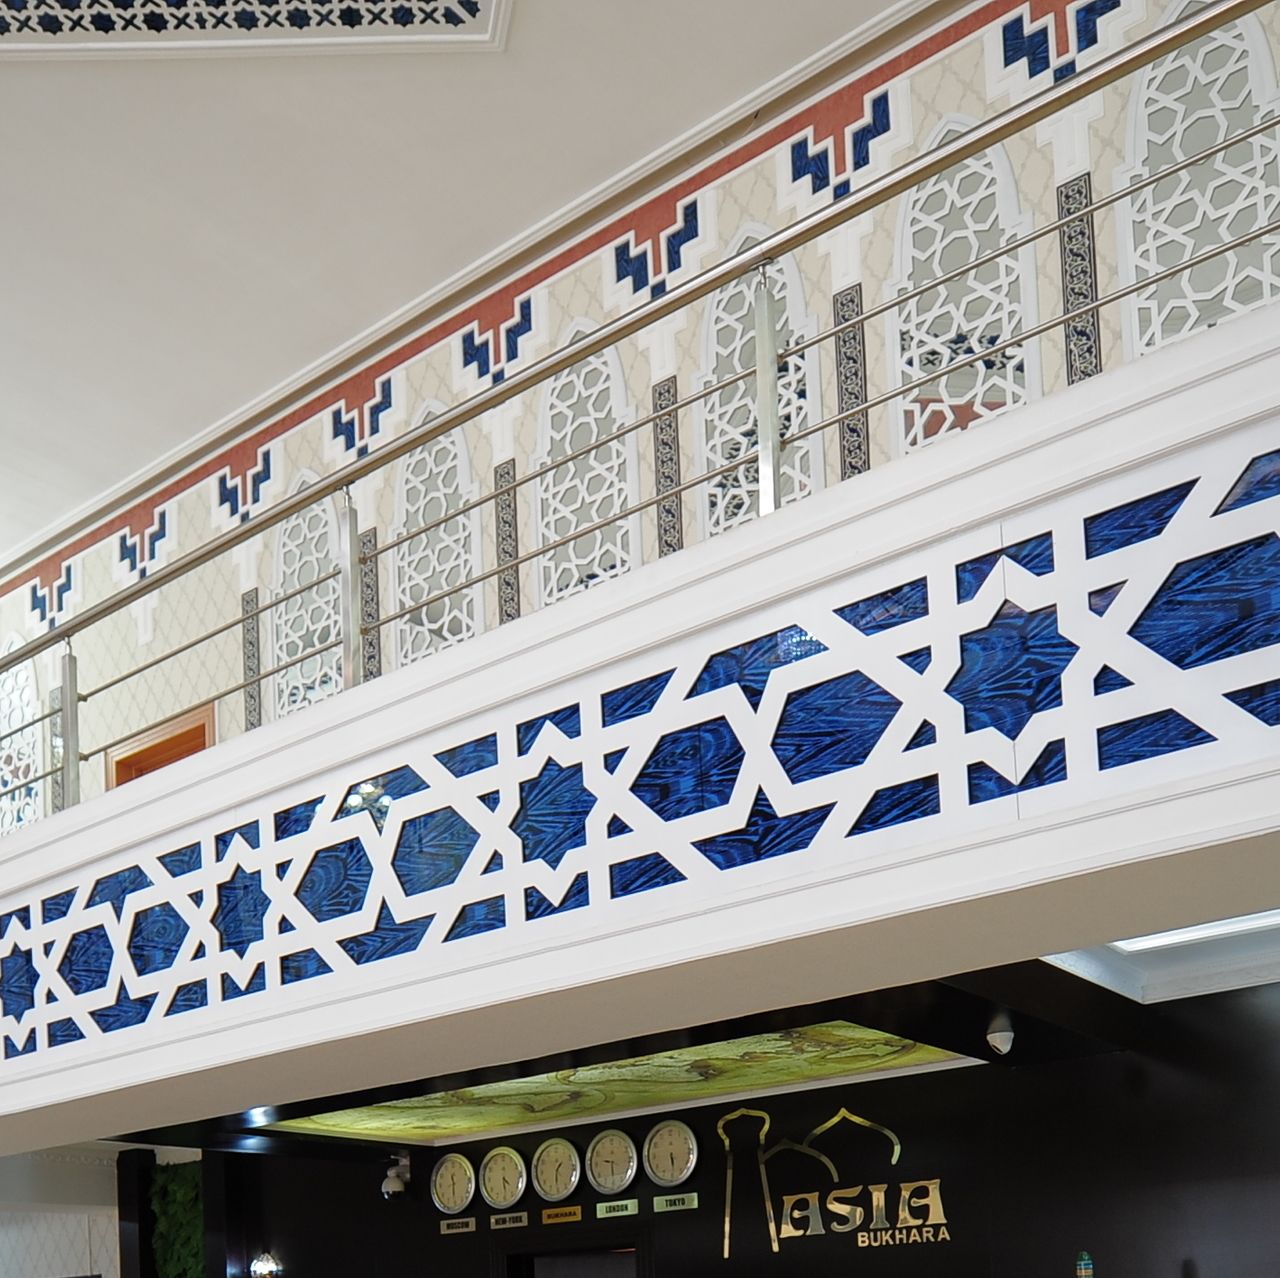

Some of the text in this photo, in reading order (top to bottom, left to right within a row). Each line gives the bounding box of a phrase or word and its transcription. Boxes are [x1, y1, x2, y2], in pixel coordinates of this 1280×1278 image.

[665, 1198, 686, 1208] TOKYO
[605, 1204, 629, 1214] LONDON
[779, 1179, 948, 1238] ASIA
[547, 1211, 577, 1219] BUKHARA
[857, 1226, 951, 1247] BUKHARA
